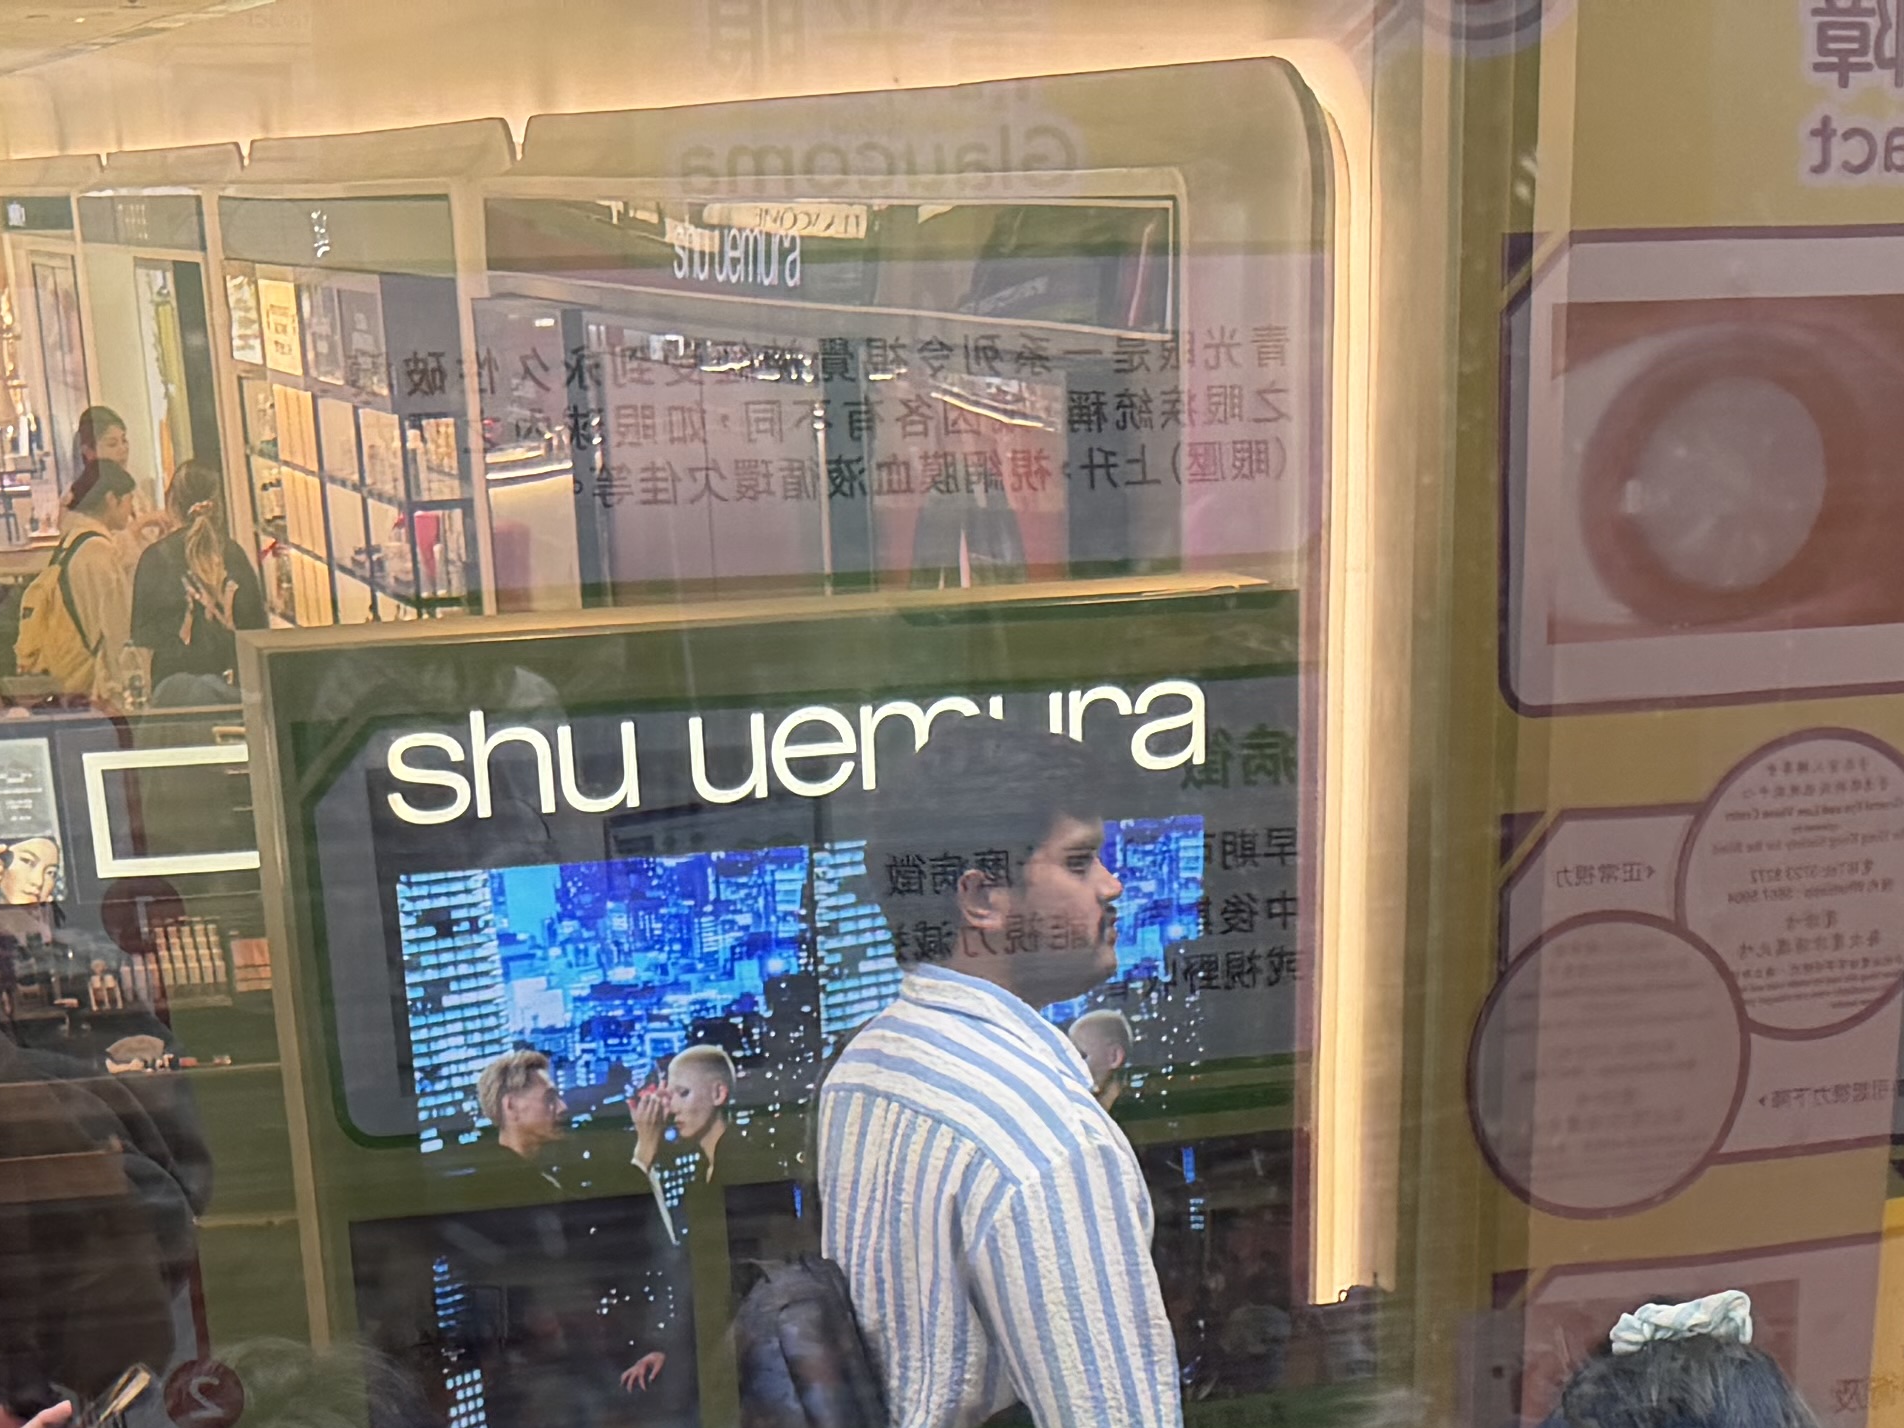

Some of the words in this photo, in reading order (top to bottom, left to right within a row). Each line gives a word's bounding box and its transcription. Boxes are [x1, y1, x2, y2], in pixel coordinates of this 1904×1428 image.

[673, 226, 710, 281] shu
[714, 226, 801, 288] uemura
[384, 709, 645, 827] shu
